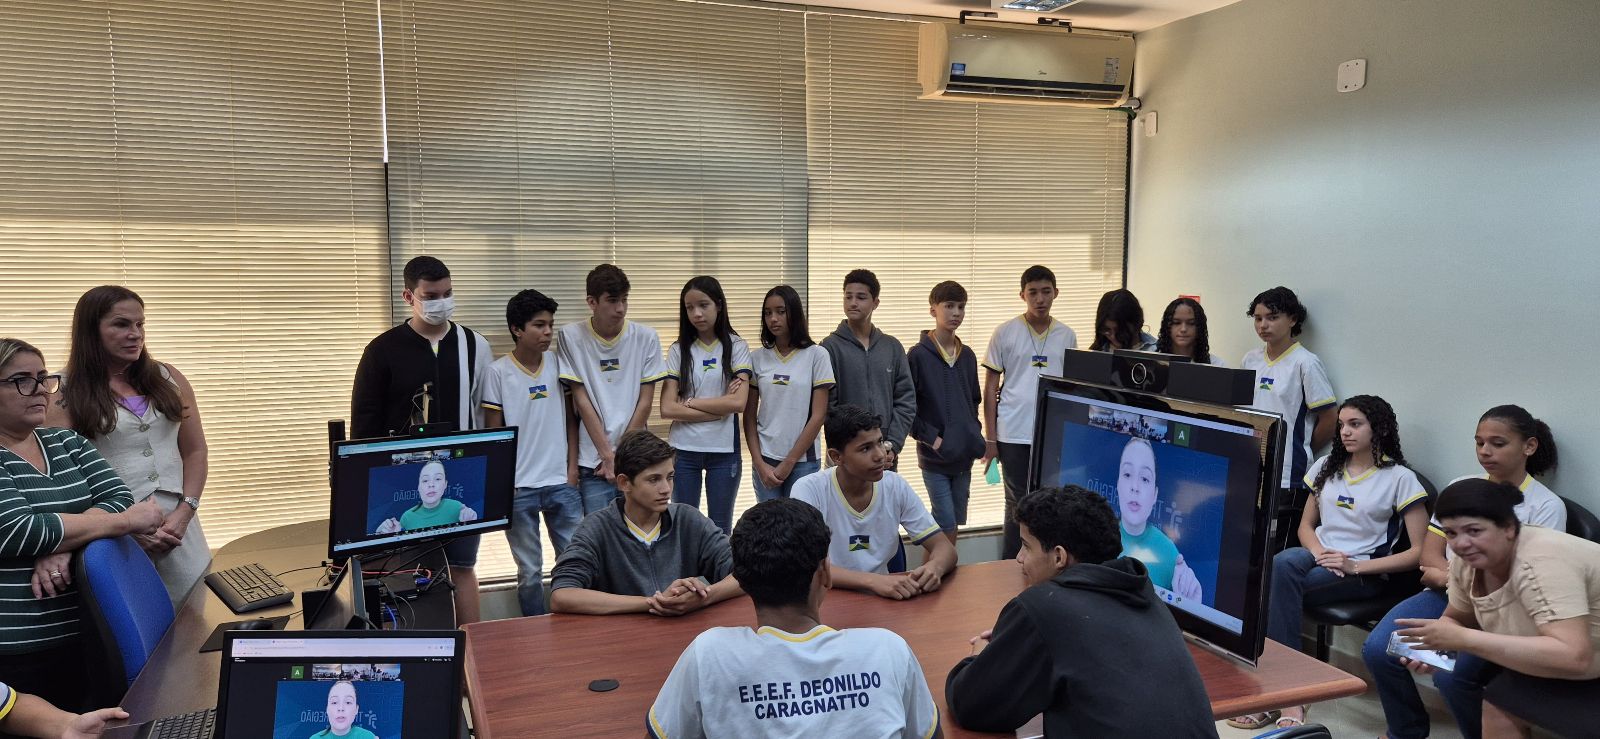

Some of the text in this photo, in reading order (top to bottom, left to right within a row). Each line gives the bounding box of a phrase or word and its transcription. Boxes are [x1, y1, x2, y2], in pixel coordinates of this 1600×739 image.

[1178, 430, 1185, 440] A
[738, 671, 881, 703] E.E.E.F. DEONILDO
[754, 692, 870, 720] CARAGNATTO
